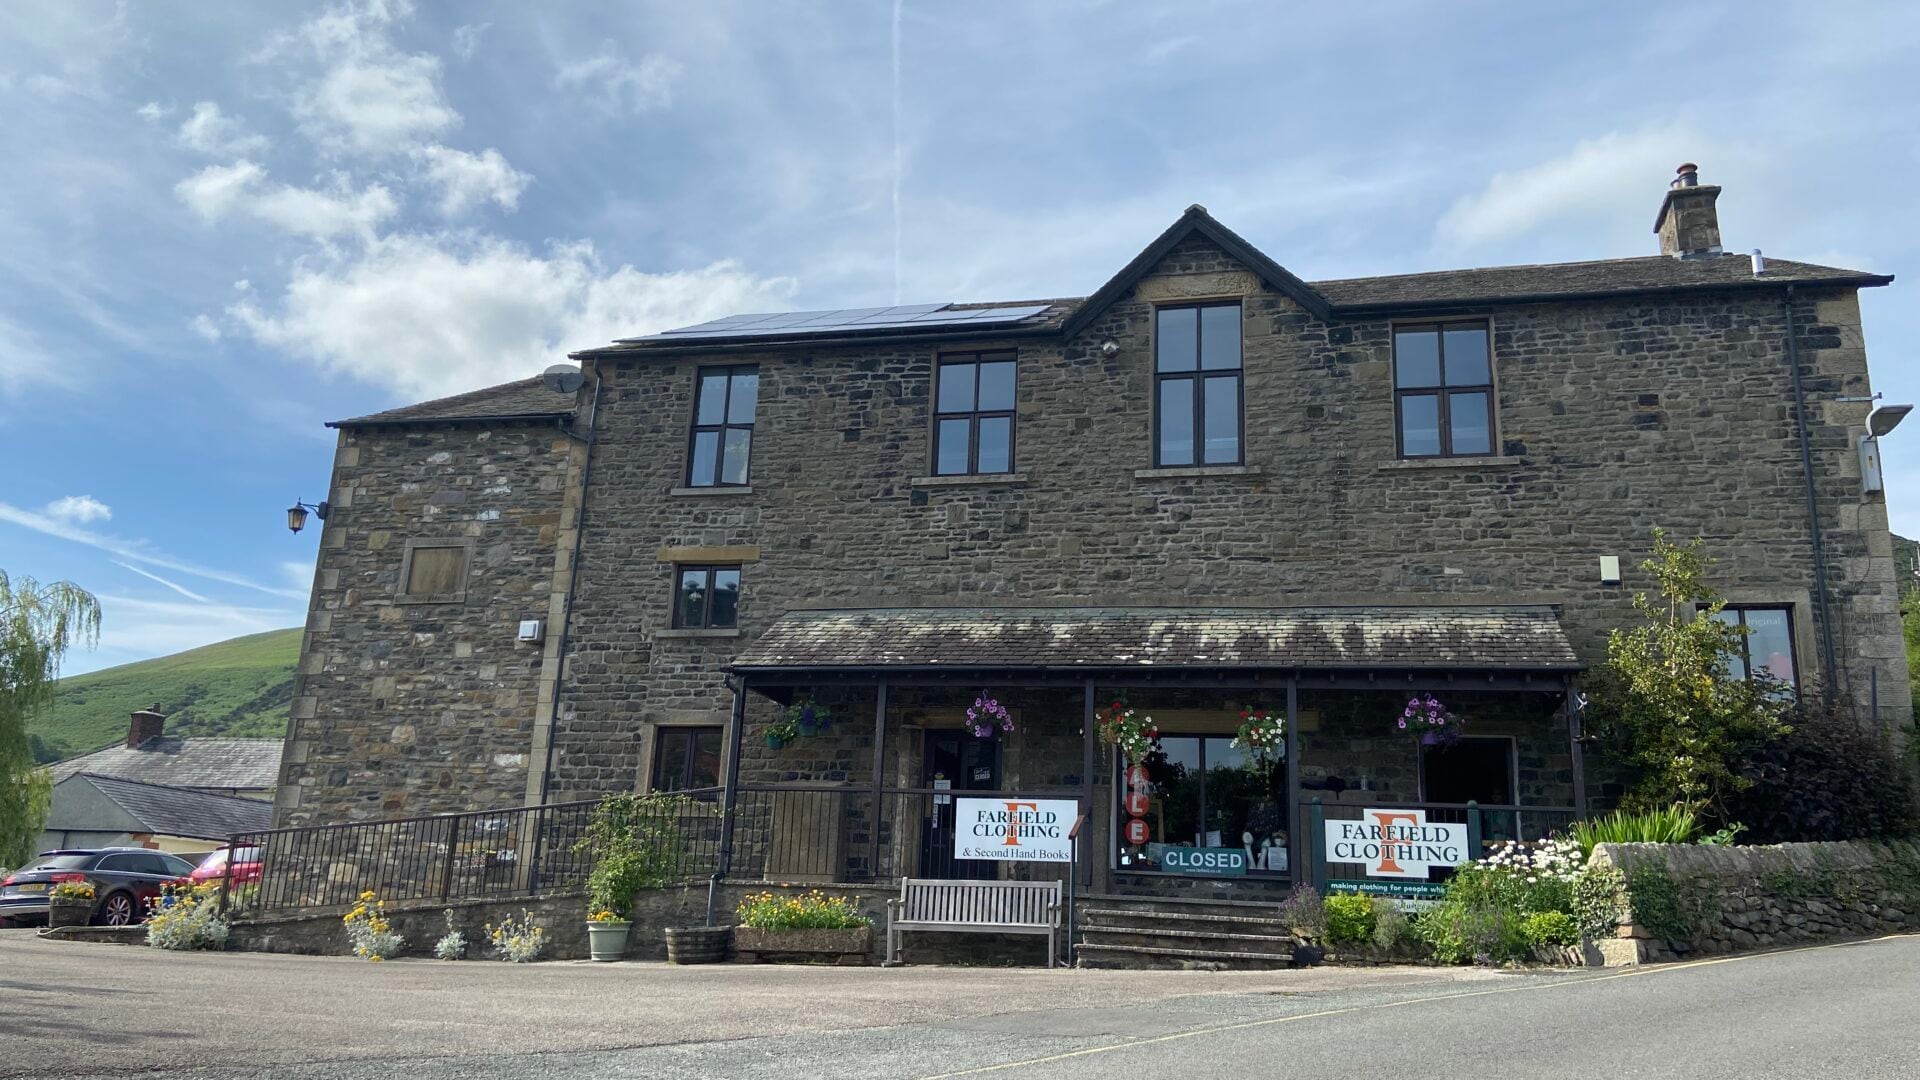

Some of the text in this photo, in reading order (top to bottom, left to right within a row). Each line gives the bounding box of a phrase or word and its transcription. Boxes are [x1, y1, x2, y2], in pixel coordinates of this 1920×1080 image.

[977, 810, 1057, 824] FARFIELD
[972, 823, 1060, 838] CLOTHING
[1341, 823, 1450, 842] FARFIELD
[962, 847, 1070, 860] & Second Hand Books
[1165, 851, 1242, 868] CLOSED
[1334, 842, 1459, 862] CLOTHING
[1331, 883, 1358, 891] making
[1359, 883, 1388, 892] clothing
[1403, 885, 1428, 893] people
